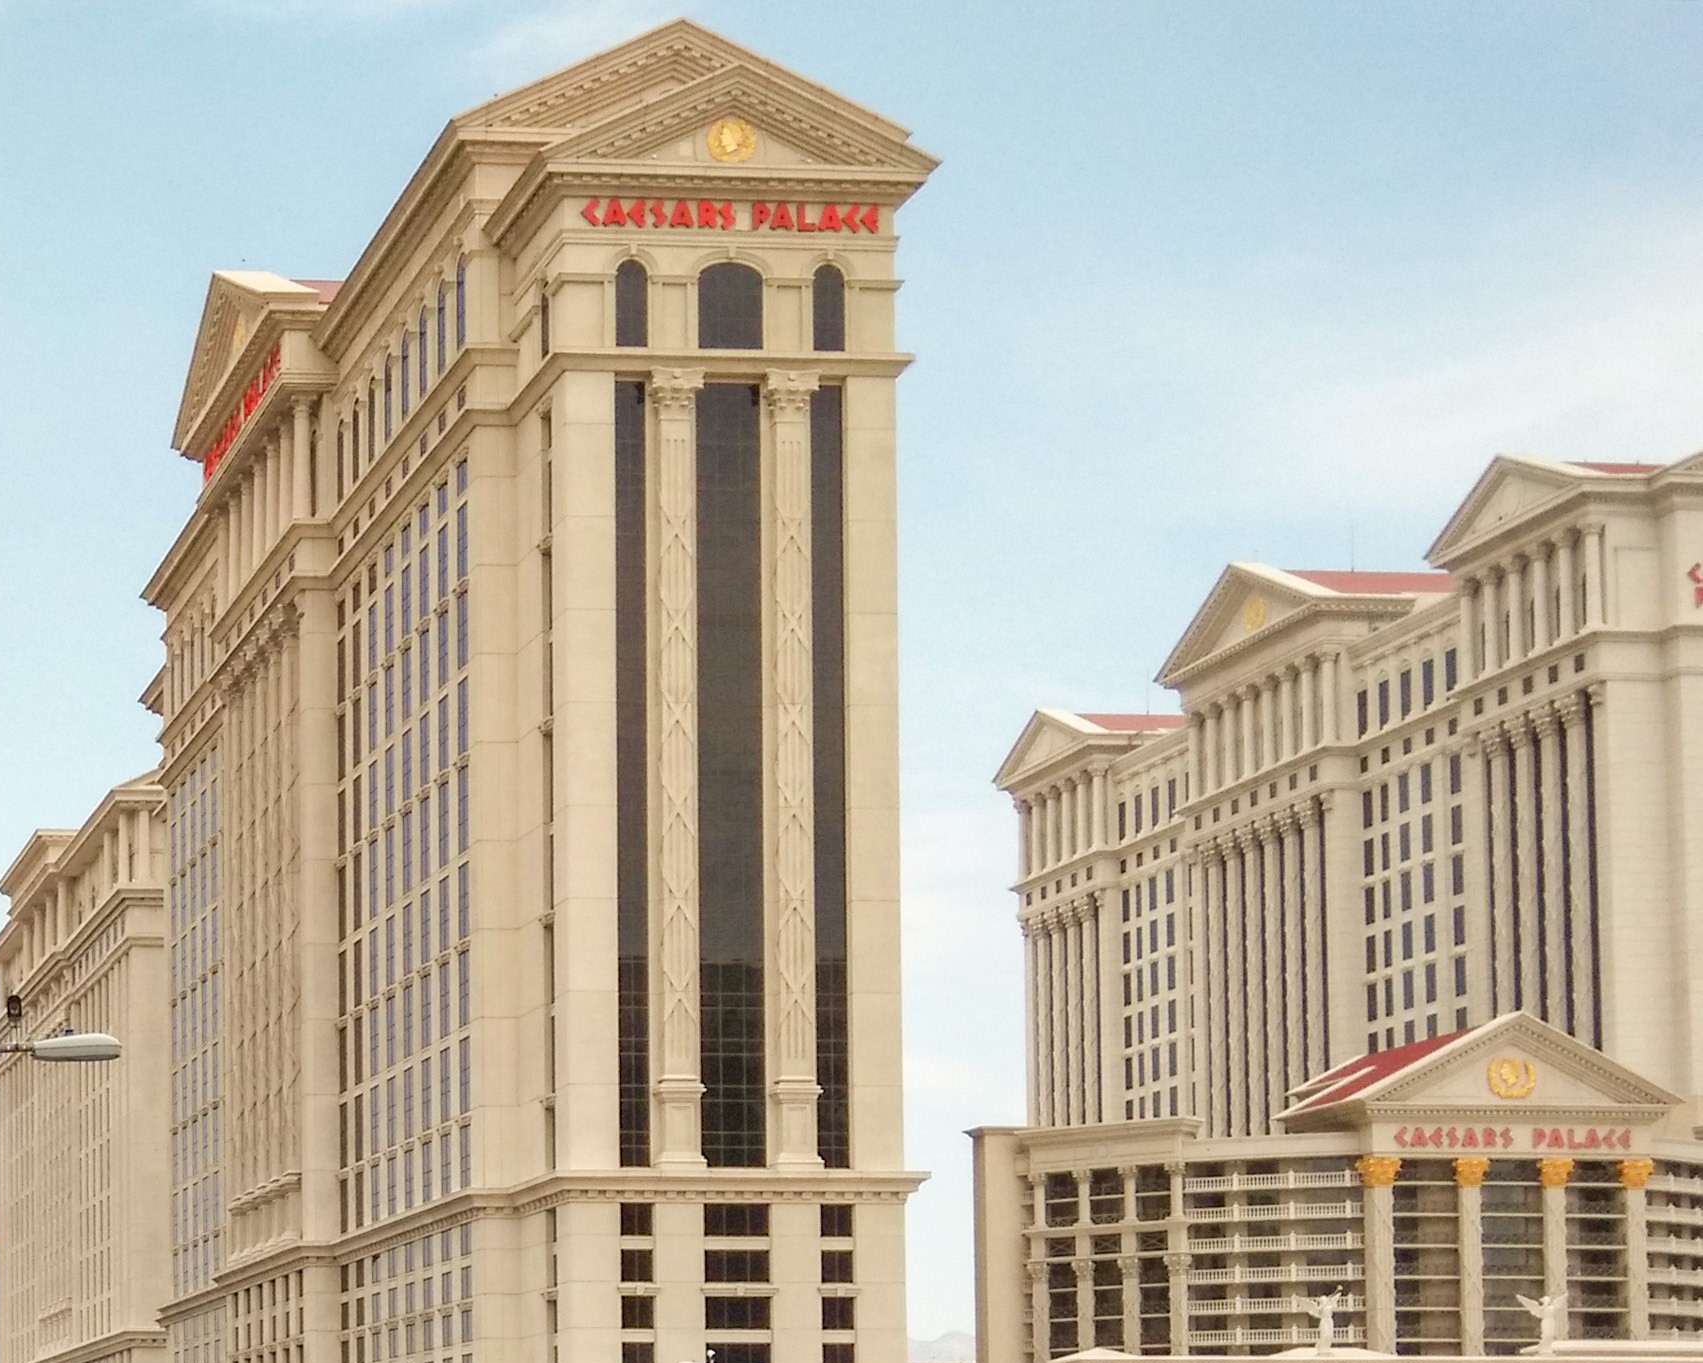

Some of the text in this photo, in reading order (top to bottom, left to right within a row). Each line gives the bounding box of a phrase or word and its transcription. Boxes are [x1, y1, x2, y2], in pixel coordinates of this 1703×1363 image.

[581, 197, 879, 234] CAESARS PALACE
[1394, 1126, 1632, 1150] CAESARS PALACE
